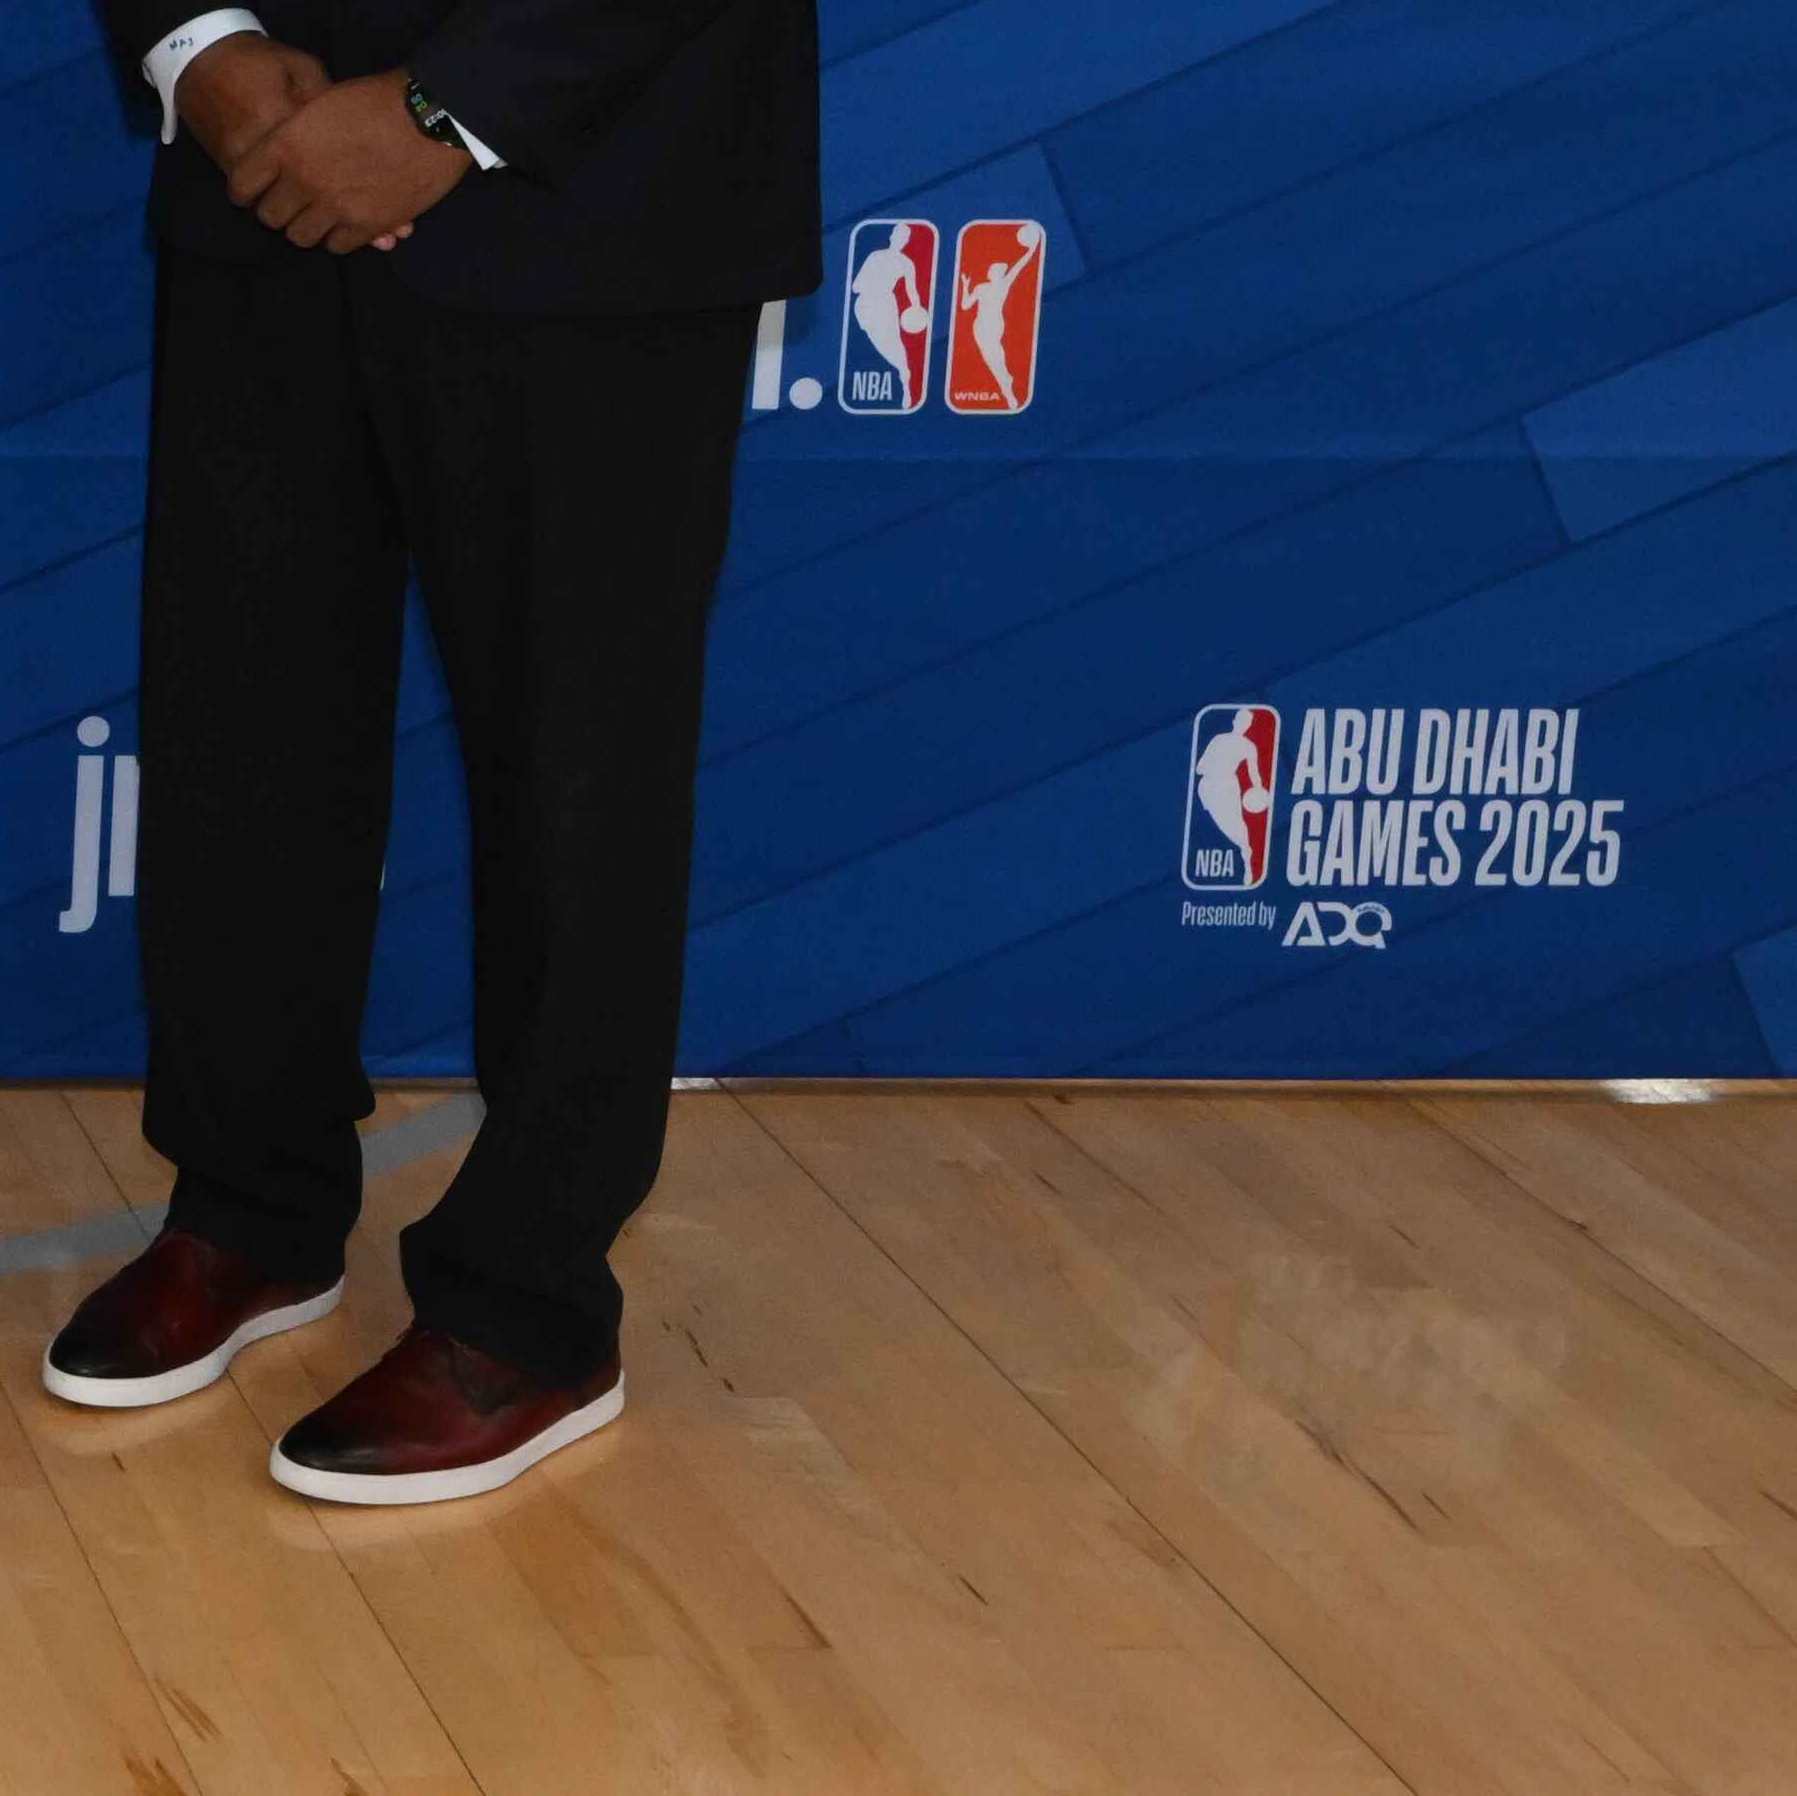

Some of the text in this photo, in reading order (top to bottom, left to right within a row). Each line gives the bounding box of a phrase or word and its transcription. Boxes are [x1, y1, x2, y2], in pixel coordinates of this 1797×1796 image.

[852, 371, 892, 401] NBA
[954, 391, 1000, 402] WNBA
[1290, 708, 1579, 796] ABU DHABI
[1286, 799, 1625, 887] GAMES 2025
[1195, 849, 1235, 877] NBA
[1181, 901, 1277, 930] Presented by
[1281, 901, 1393, 949] ADQ
